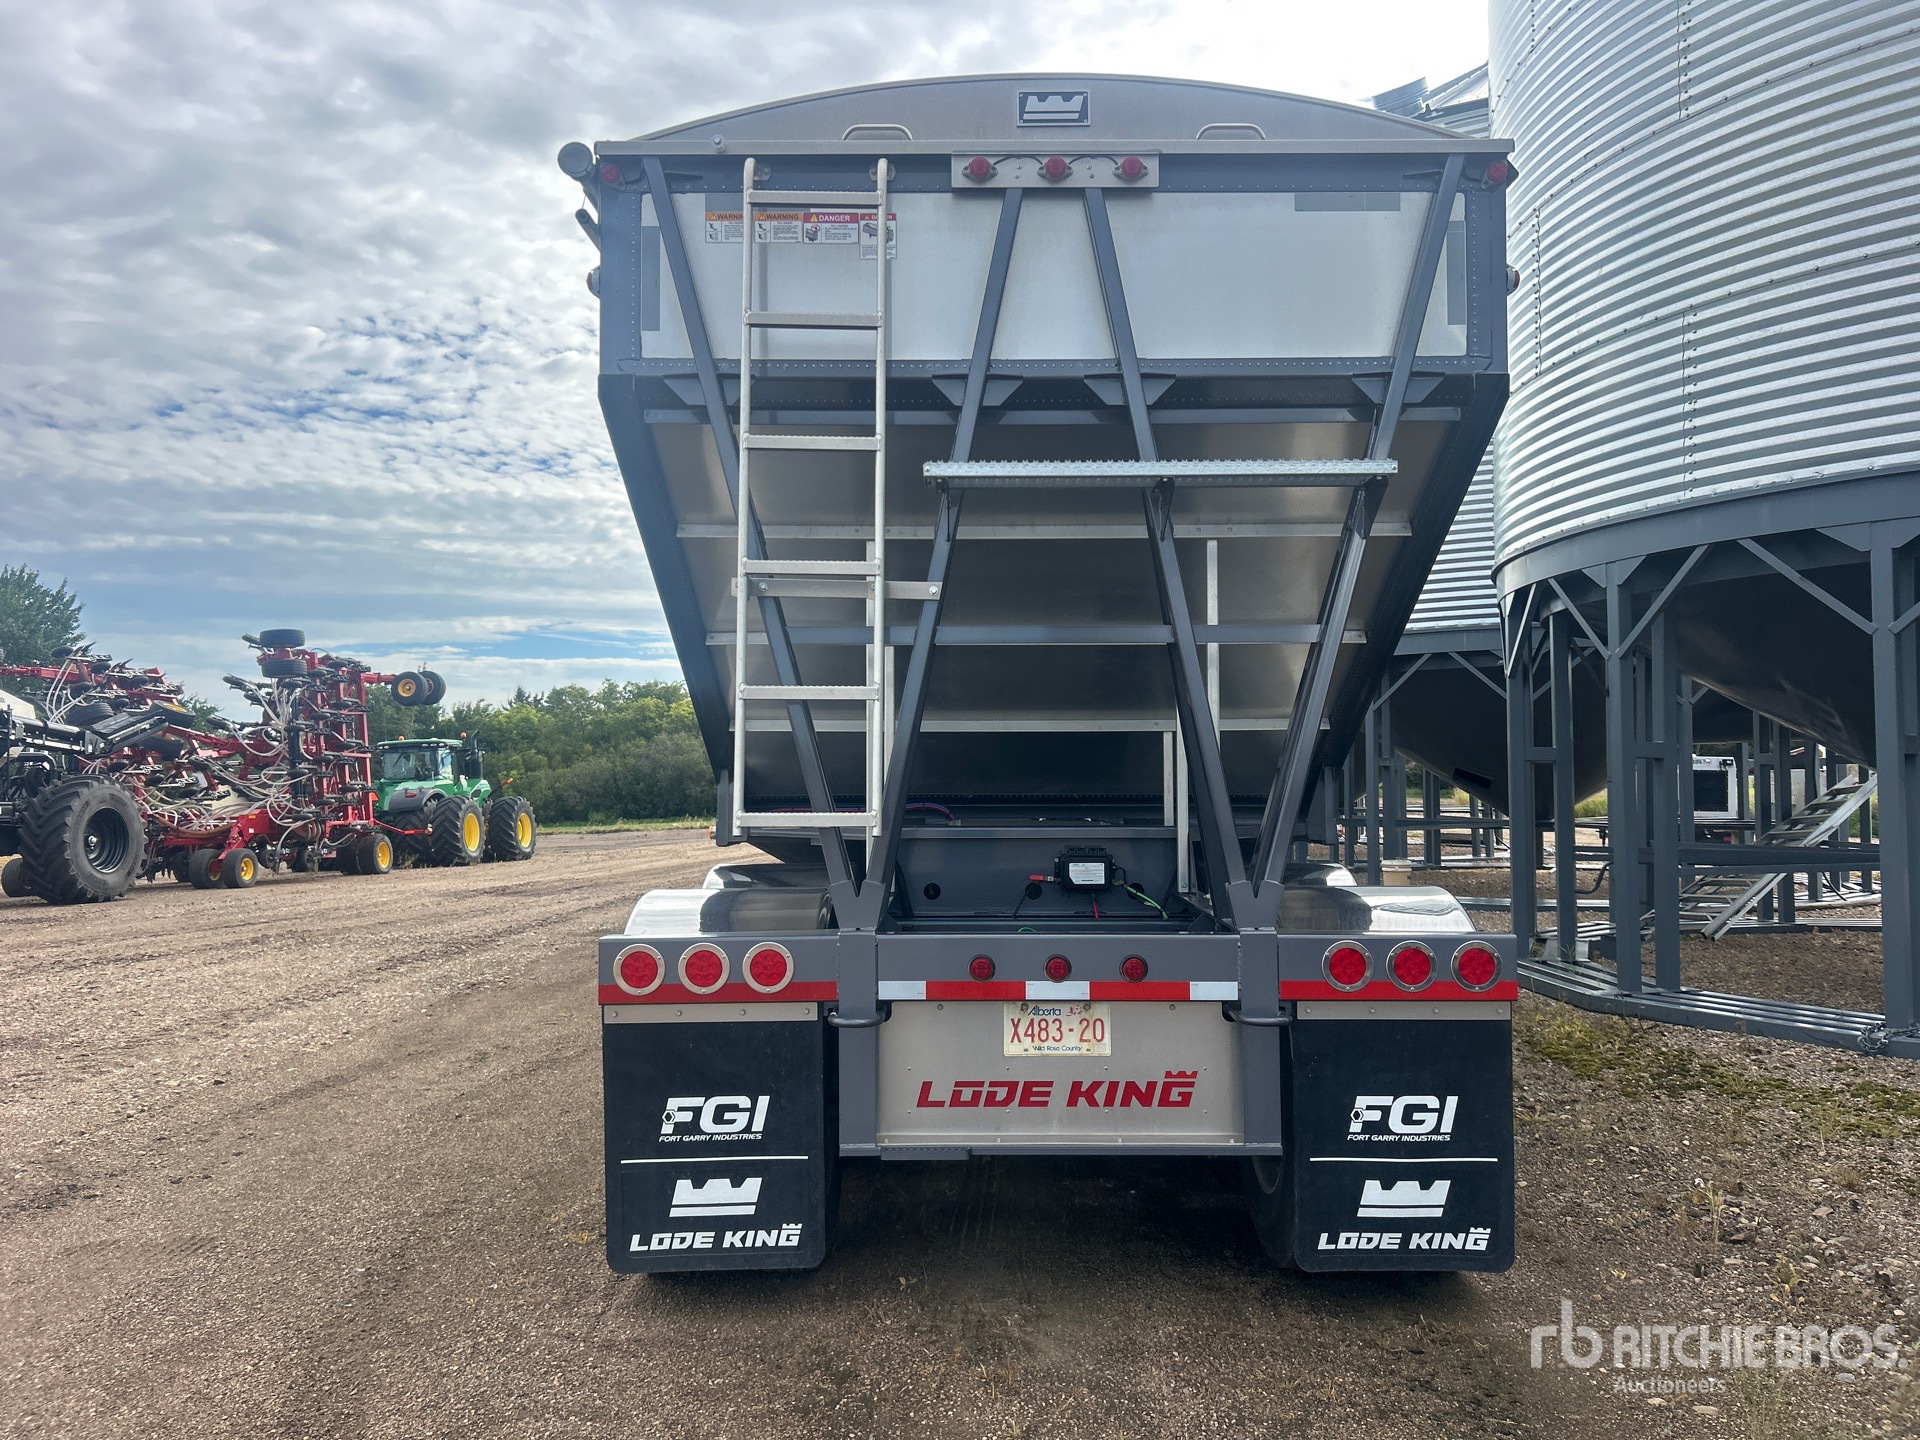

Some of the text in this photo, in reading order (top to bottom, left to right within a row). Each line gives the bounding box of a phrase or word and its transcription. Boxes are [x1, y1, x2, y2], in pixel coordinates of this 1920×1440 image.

[818, 214, 851, 222] DANGER
[1028, 1004, 1061, 1016] Alberta
[1010, 1018, 1105, 1043] X483-20
[916, 1073, 1198, 1108] LODE KING
[660, 1095, 771, 1135] FGI
[1349, 1095, 1459, 1134] FGI
[659, 1133, 762, 1142] FORT GARRY INDUSTRIES
[1371, 1134, 1400, 1142] GARRY
[1401, 1134, 1451, 1142] INDUSTRIES
[629, 1226, 802, 1252] LODE KING
[1317, 1229, 1491, 1251] LODE KING
